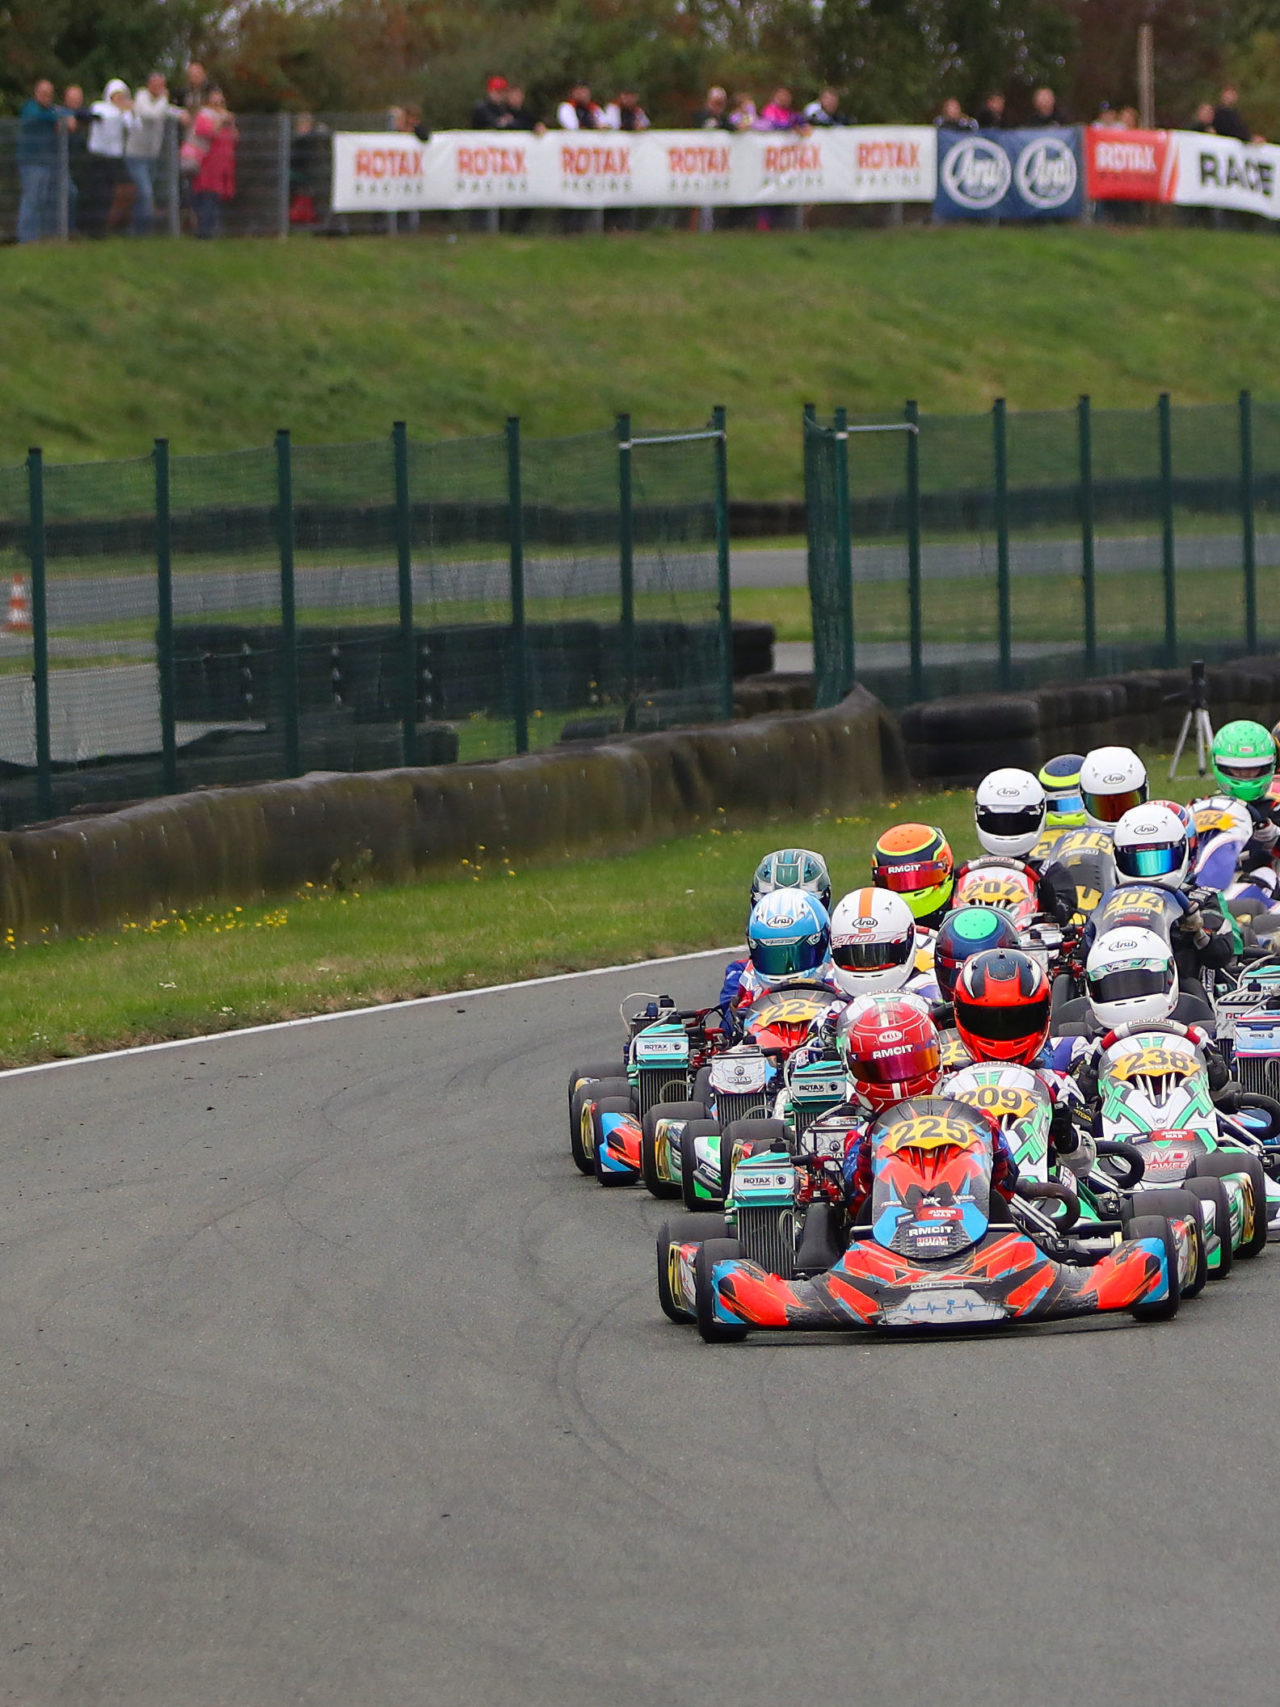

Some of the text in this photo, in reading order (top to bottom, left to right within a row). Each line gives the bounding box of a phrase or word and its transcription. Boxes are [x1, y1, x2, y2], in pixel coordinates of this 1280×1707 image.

[355, 149, 424, 177] ROTAX
[457, 147, 527, 175] ROTAX
[561, 146, 631, 174] ROTAX
[668, 147, 730, 173] ROTAX
[857, 143, 919, 168] ROTAX
[1200, 153, 1273, 197] RACE
[888, 863, 921, 874] RMCIT
[767, 916, 793, 927] Arai
[853, 917, 878, 928] Arai
[766, 1001, 825, 1025] 22
[882, 1032, 899, 1040] BELL
[872, 1044, 913, 1060] RMCIT
[1125, 1049, 1189, 1074] 238
[893, 1118, 968, 1149] 225
[908, 1226, 953, 1237] RMCIT
